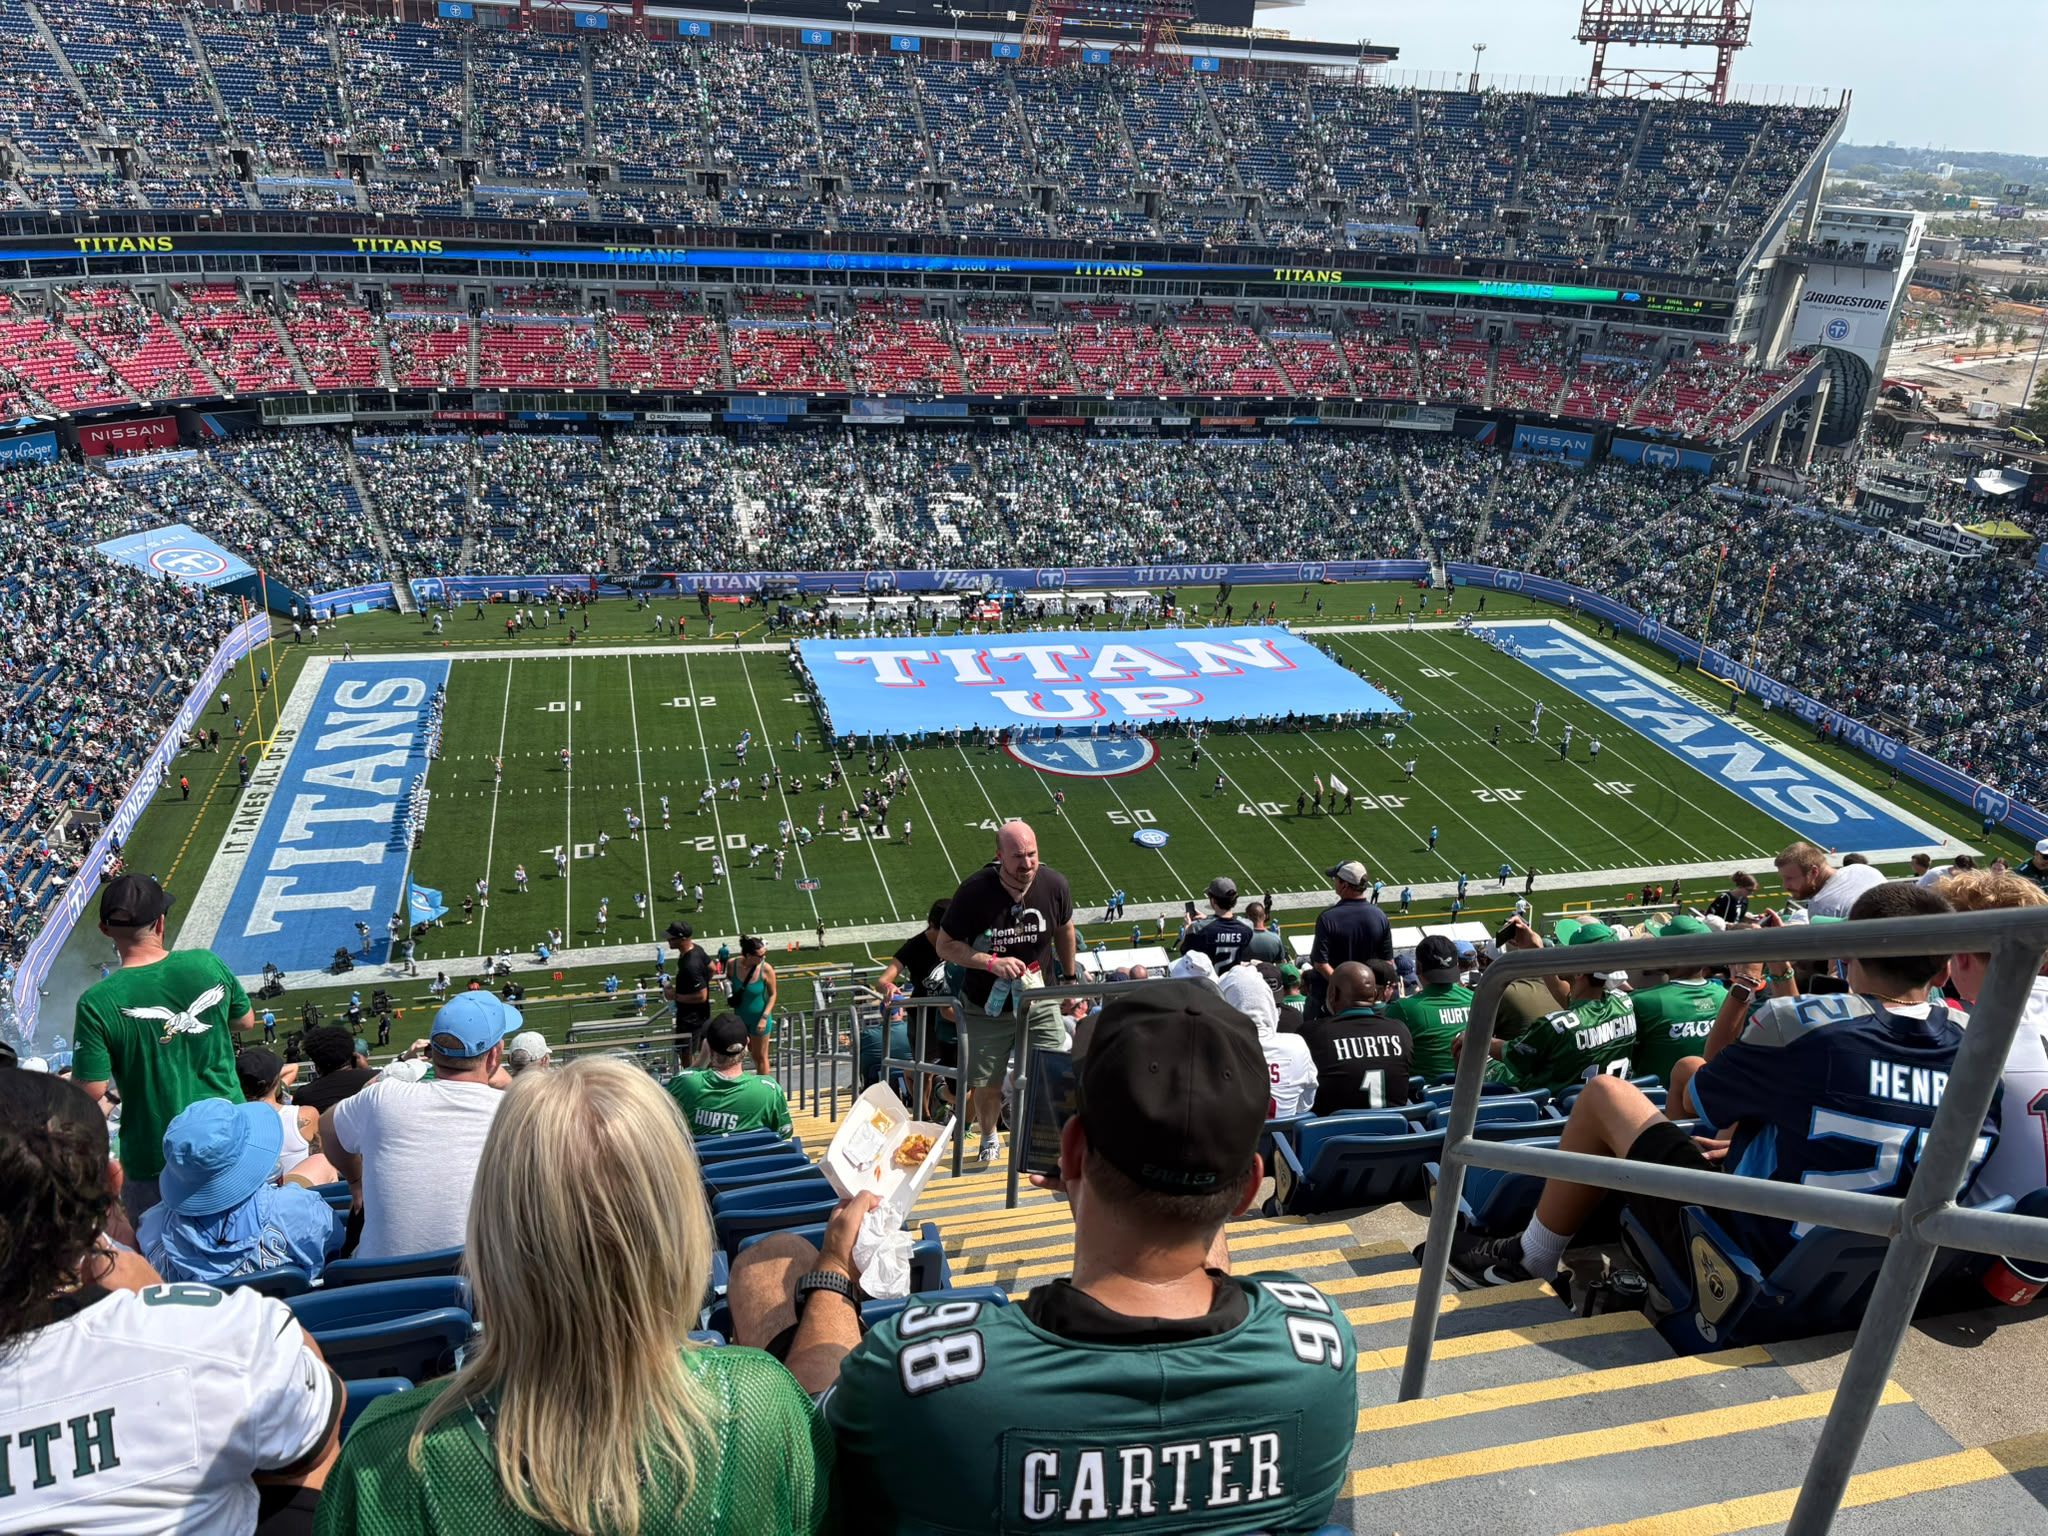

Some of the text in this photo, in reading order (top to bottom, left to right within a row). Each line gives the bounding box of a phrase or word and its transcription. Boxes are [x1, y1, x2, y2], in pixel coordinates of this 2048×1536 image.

[74, 236, 174, 252] TITANS
[352, 238, 443, 254] TITANS
[604, 247, 688, 264] TITANS
[1073, 262, 1144, 277] TITANS
[1273, 268, 1342, 283] TITANS
[1478, 280, 1554, 299] TITANS
[1803, 290, 1889, 310] BRIDGESTONE
[91, 424, 165, 442] NISSAN
[1518, 432, 1588, 450] NISSAN
[15, 442, 52, 461] Kroger
[117, 534, 186, 556] NISSAN
[211, 573, 242, 588] NISSAN
[687, 574, 761, 590] TITAN
[933, 571, 1004, 590] Titas
[1134, 567, 1229, 582] TITAN UP
[834, 637, 1297, 688] TITAN
[990, 687, 1205, 719] UP
[1521, 639, 1875, 824] TITANS
[1731, 718, 1783, 747] LOVE
[222, 729, 297, 855] IT TAKES ALL OF US
[1470, 787, 1523, 803] 20
[1594, 780, 1635, 796] 10
[243, 677, 426, 937] TITANS
[1237, 801, 1284, 817] 40
[1354, 794, 1406, 811] 30
[1106, 809, 1159, 825] 50
[694, 833, 748, 852] 20
[842, 824, 892, 843] 30
[553, 843, 596, 859] 10
[993, 933, 1038, 948] istening
[1215, 932, 1242, 943] JONES
[993, 945, 1007, 953] ab
[1439, 1007, 1472, 1025] HURT
[1333, 1034, 1402, 1061] HURTS
[1360, 1069, 1387, 1109] 1
[1869, 1058, 1950, 1107] HENR
[694, 1108, 739, 1131] HURTS
[1020, 1430, 1287, 1525] CARTER
